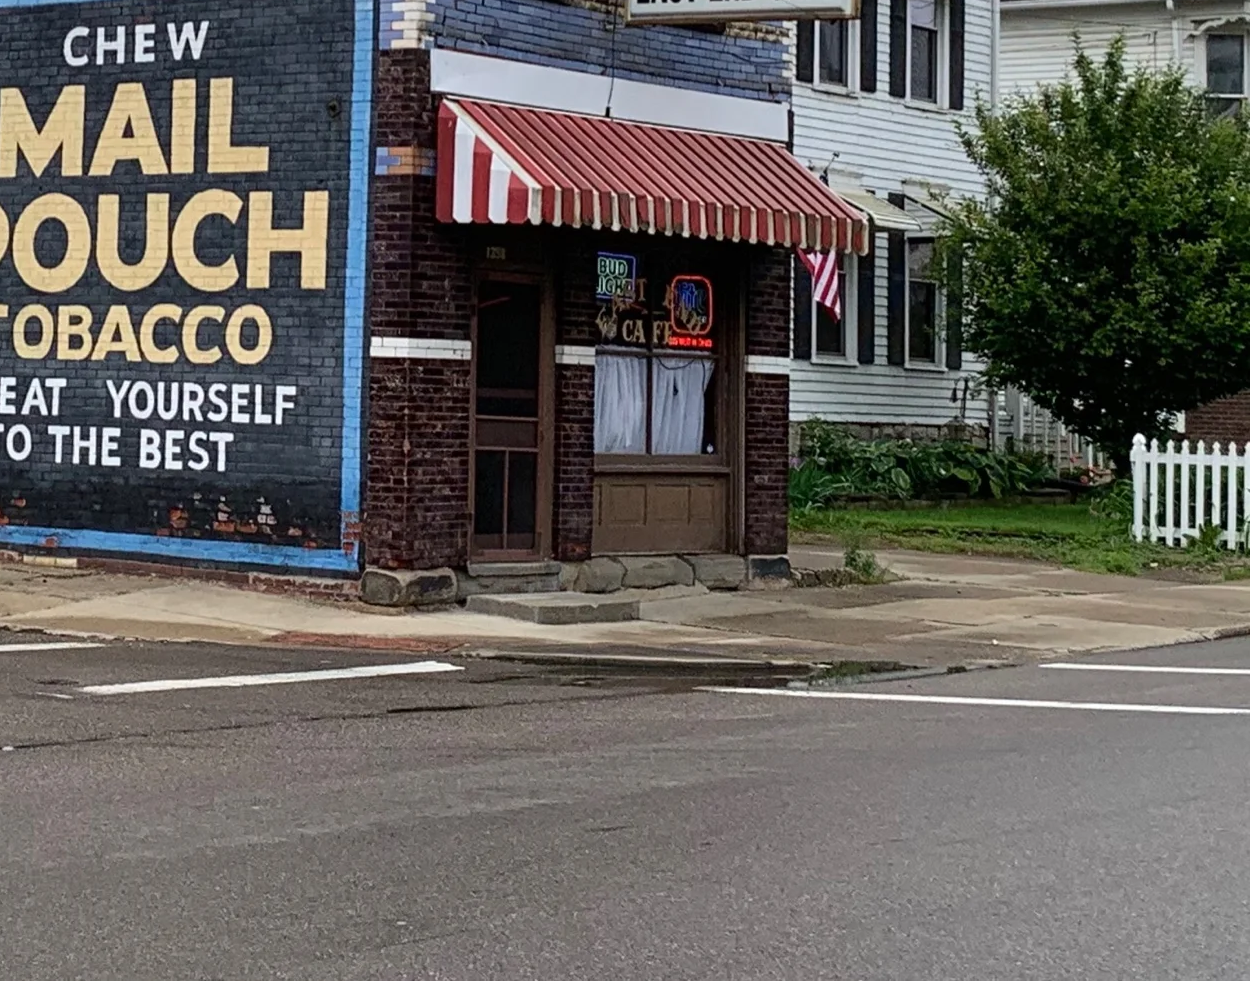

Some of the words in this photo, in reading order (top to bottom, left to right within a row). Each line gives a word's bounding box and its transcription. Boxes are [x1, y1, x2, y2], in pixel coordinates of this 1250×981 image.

[63, 20, 209, 67] CHEW
[597, 257, 628, 278] BUD
[106, 380, 297, 424] YOURSELF
[48, 424, 121, 467] THE
[139, 430, 234, 472] BEST
